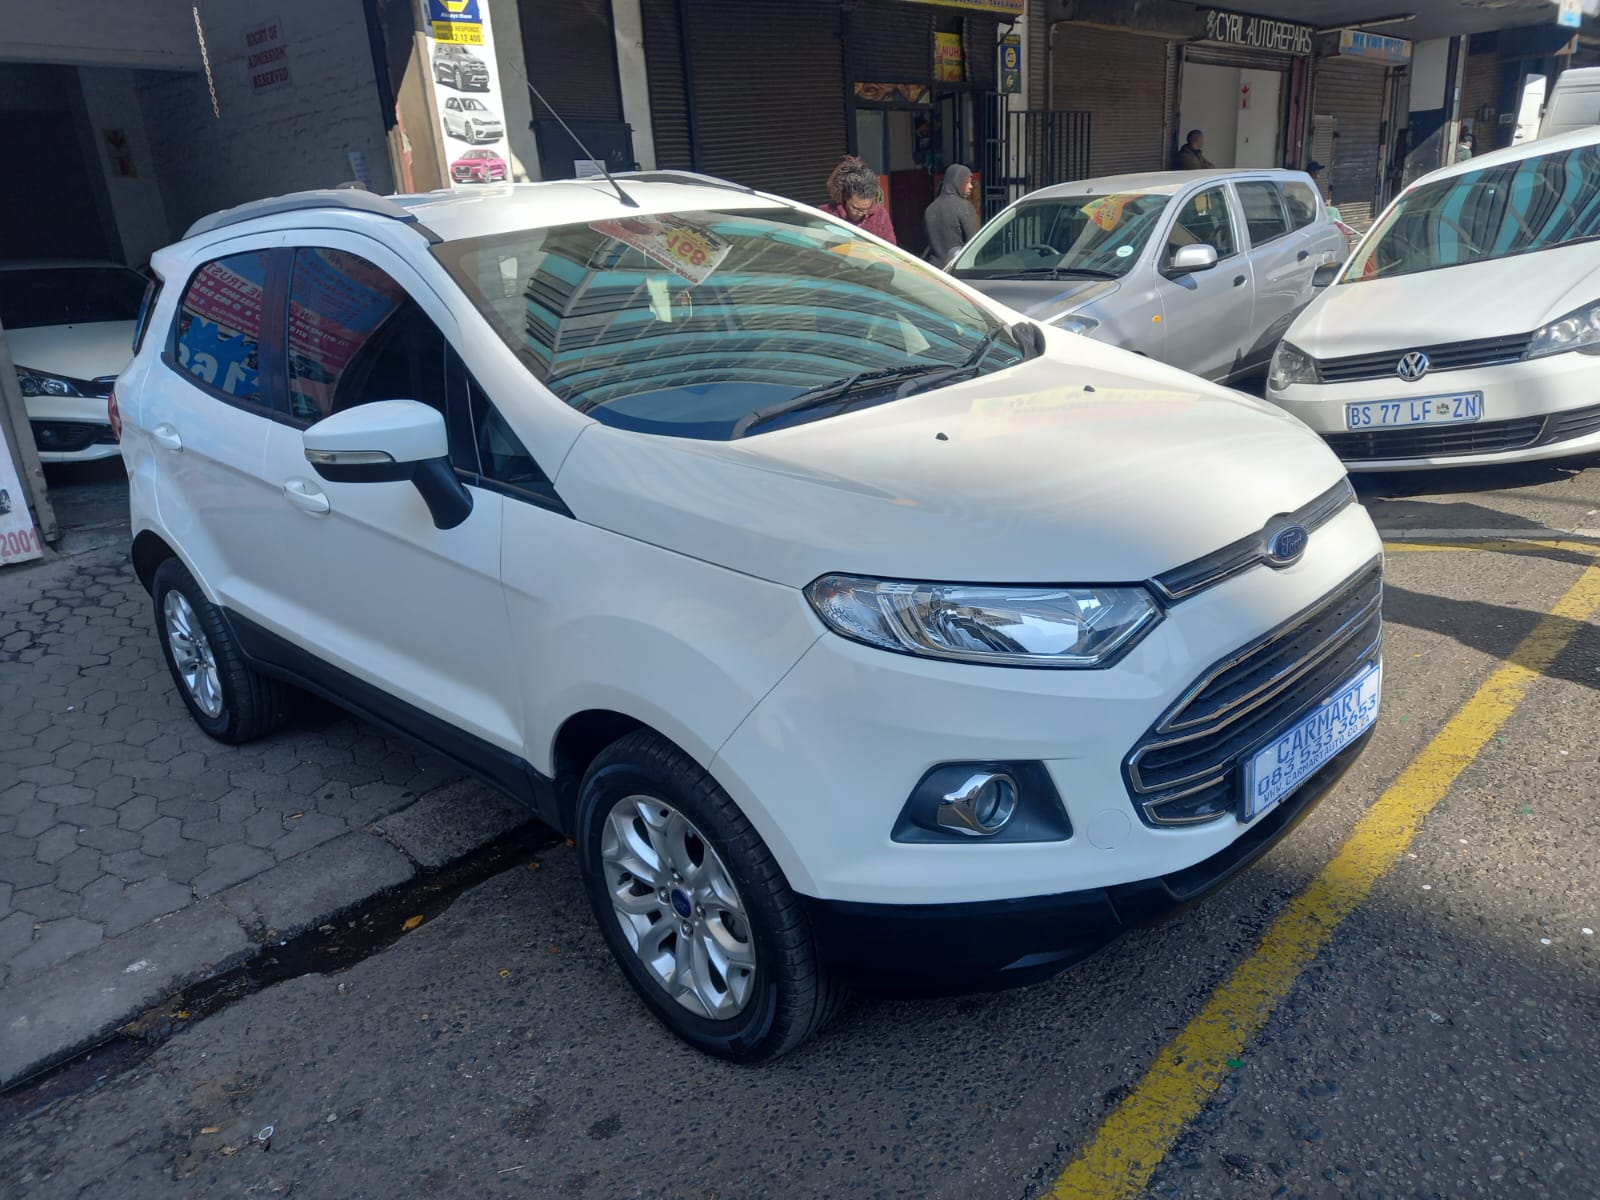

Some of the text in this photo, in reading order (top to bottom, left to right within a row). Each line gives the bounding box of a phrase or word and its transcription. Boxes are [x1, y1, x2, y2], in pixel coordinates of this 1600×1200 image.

[1351, 397, 1477, 426] BS 77 LF ZN
[1258, 758, 1294, 796] 083
[1300, 727, 1333, 763] 533
[1338, 692, 1376, 735] 3653
[1277, 685, 1364, 764] CARMART
